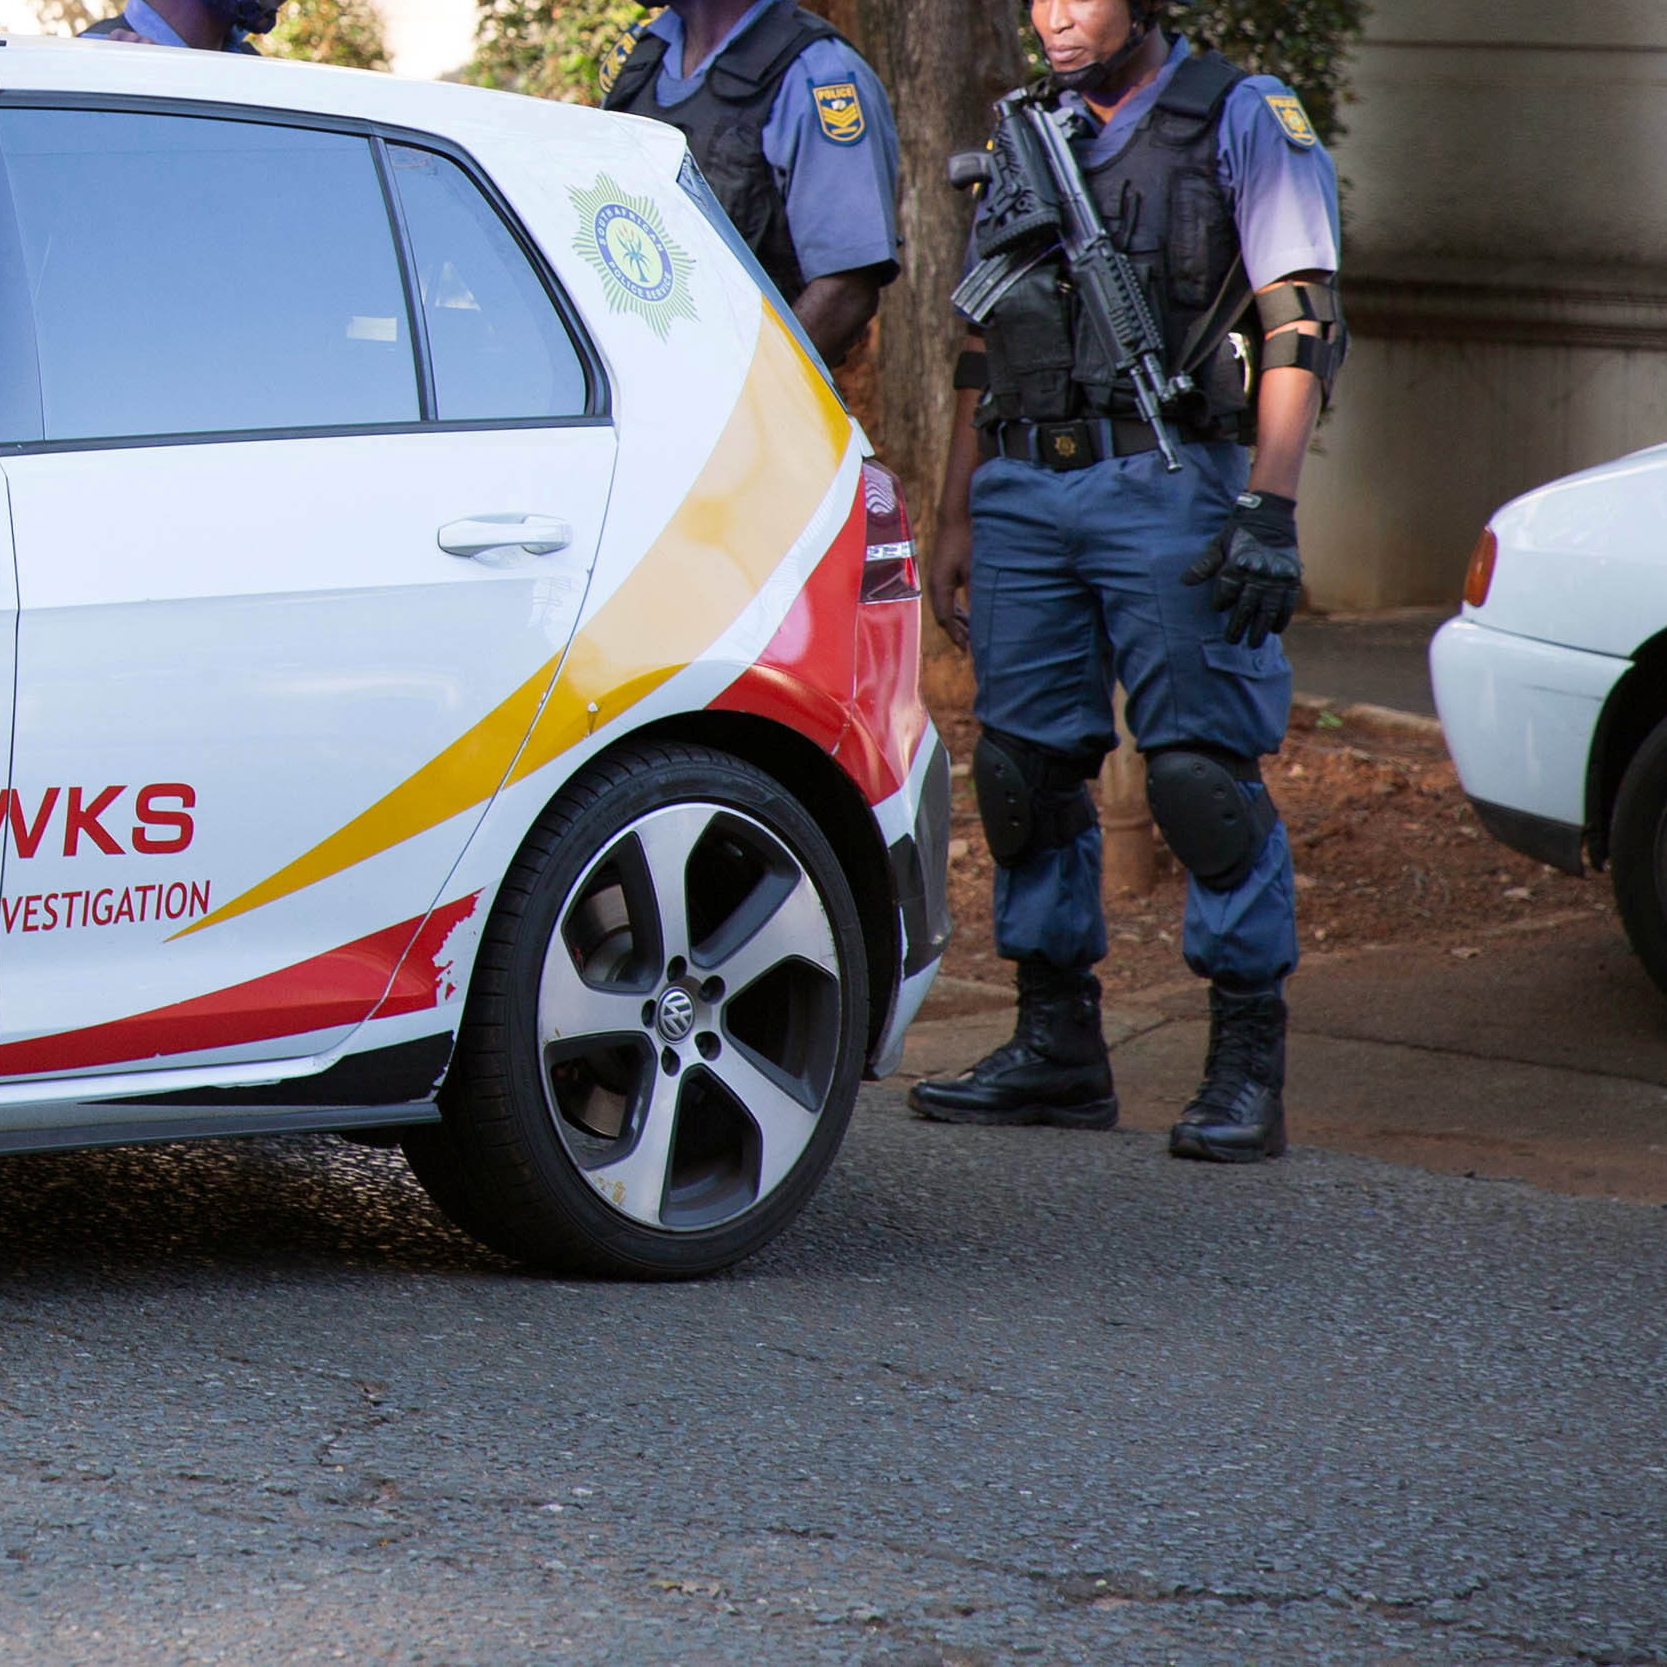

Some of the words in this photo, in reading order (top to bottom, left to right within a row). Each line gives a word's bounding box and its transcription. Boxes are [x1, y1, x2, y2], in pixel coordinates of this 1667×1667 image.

[817, 86, 853, 101] POLICE
[597, 206, 613, 246] SOUTH
[613, 206, 665, 252] AFRICAN
[608, 260, 644, 299] POLICE
[645, 270, 672, 301] SERVICE
